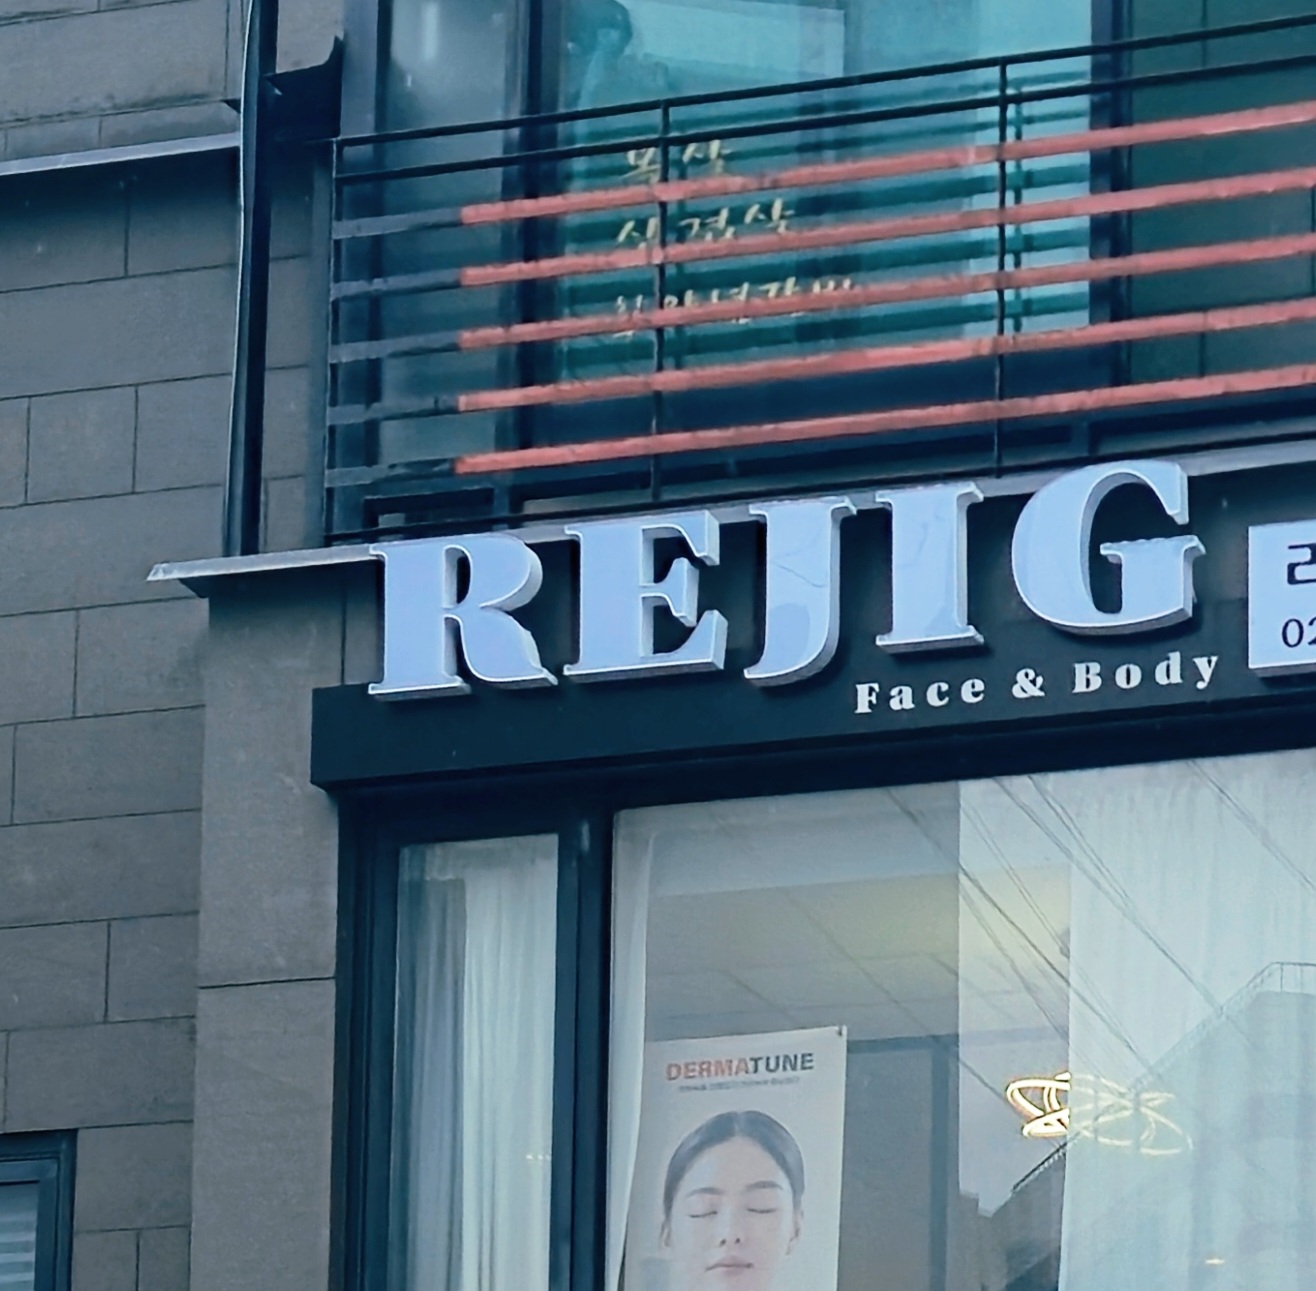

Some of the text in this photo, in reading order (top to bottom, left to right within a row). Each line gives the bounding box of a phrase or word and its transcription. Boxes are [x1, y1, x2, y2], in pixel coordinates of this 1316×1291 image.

[367, 459, 1206, 702] REJIG
[854, 650, 1219, 714] Face & Body
[665, 1052, 815, 1081] DERMATUNE
